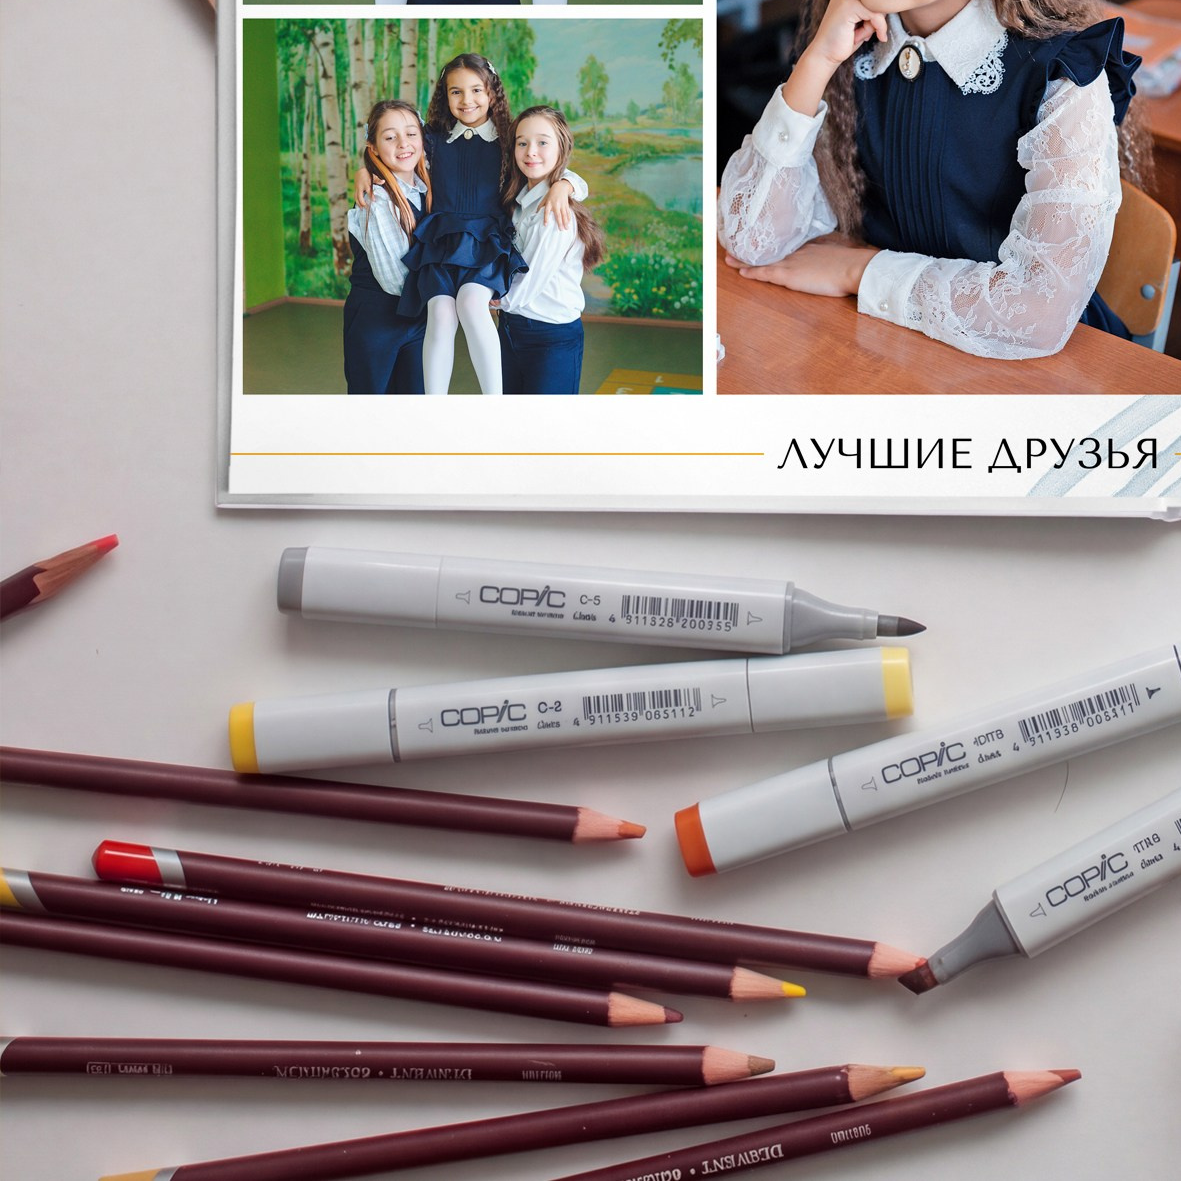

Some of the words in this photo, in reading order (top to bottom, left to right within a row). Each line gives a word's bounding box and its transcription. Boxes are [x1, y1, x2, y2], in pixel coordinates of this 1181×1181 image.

[777, 438, 973, 469] ЛУЧШИЕ
[988, 437, 1158, 473] ДРУЗЬЯ
[537, 700, 562, 714] C-2
